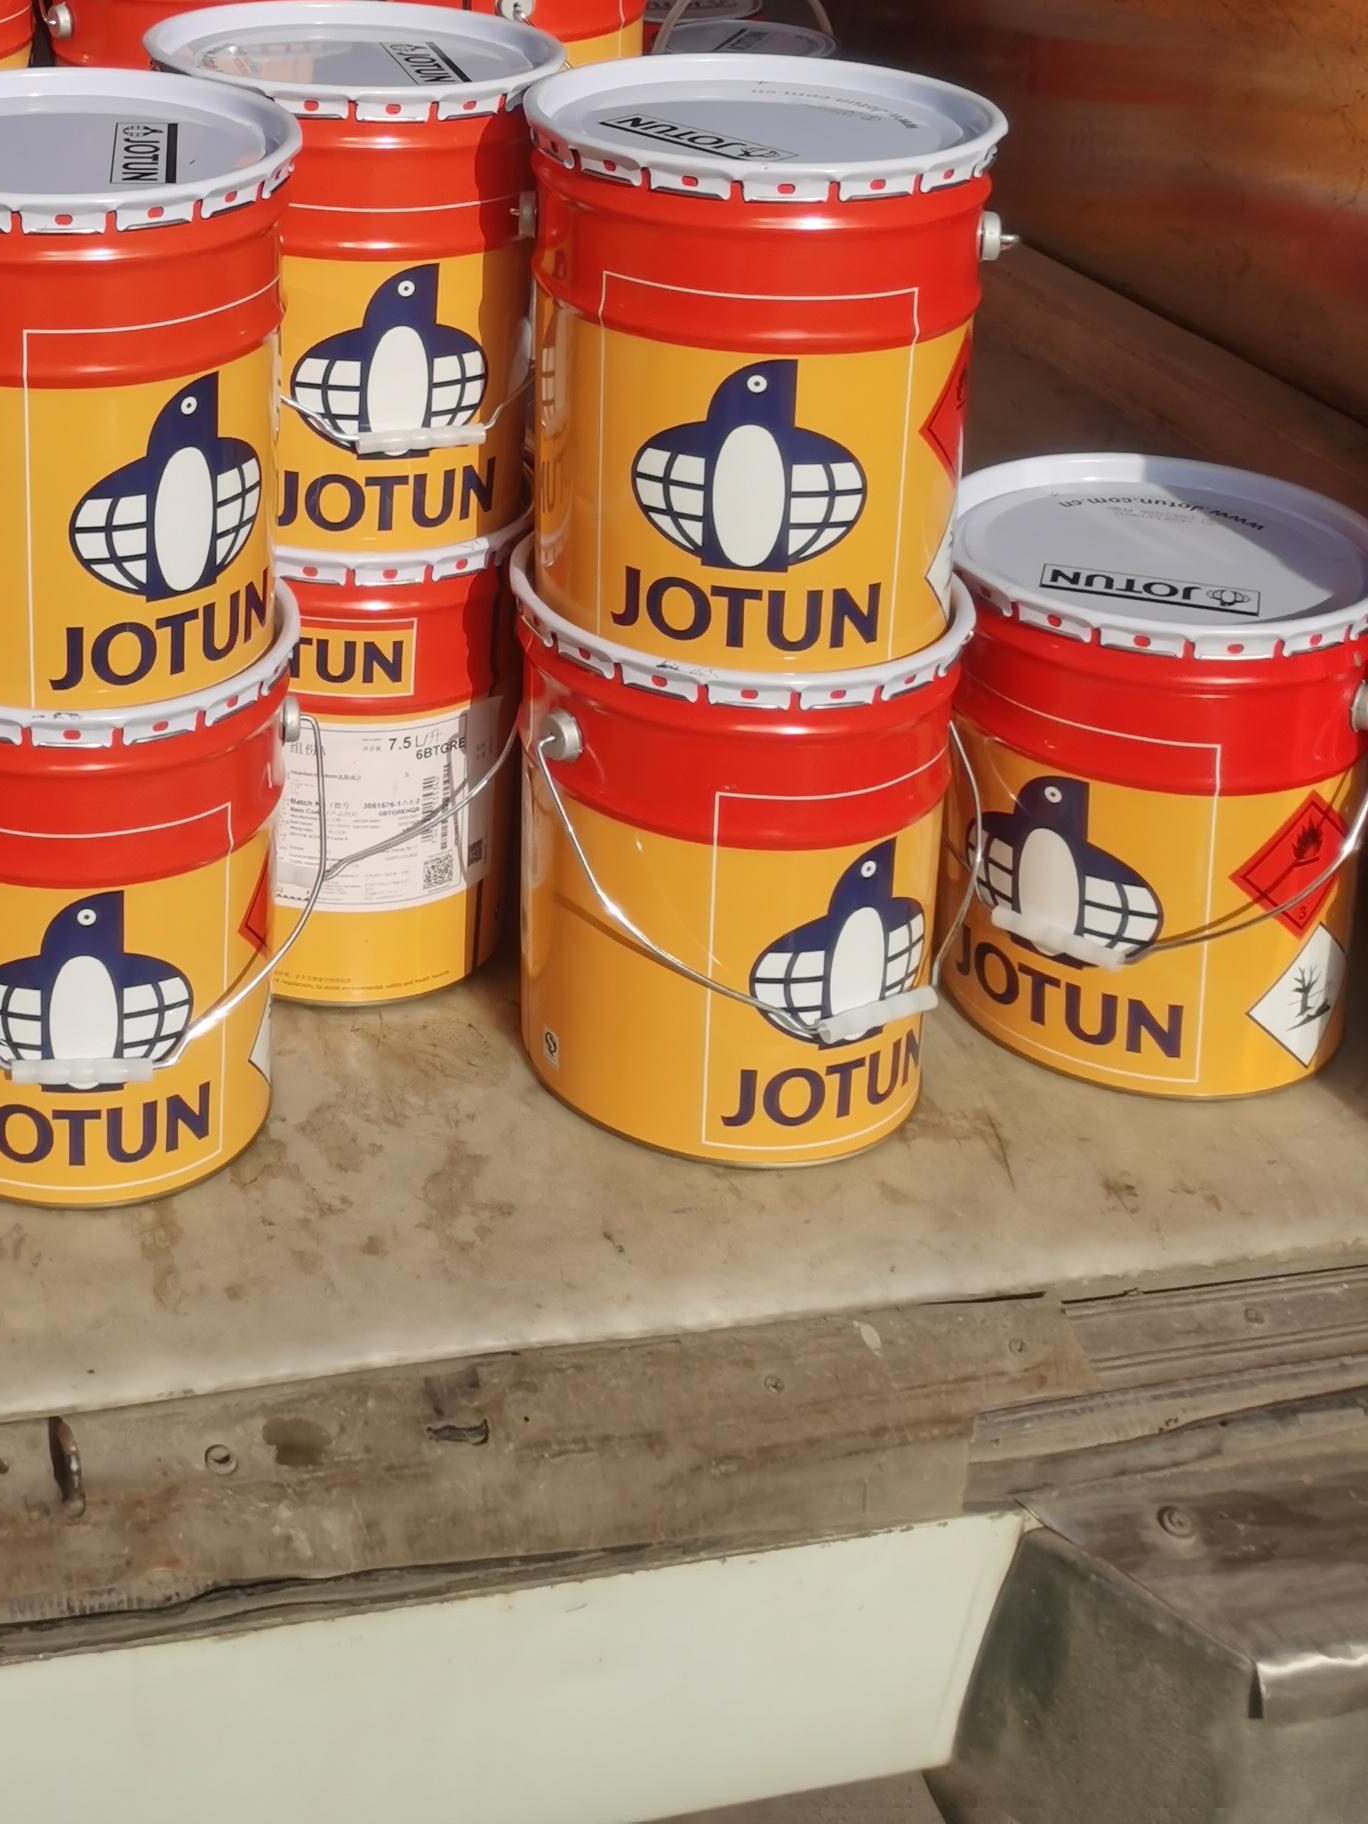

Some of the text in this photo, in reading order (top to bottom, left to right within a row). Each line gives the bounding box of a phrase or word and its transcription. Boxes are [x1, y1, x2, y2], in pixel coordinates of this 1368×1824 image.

[617, 116, 744, 148] JOTUN
[122, 138, 159, 182] JOTUN
[277, 457, 495, 532] JOTUN
[1051, 568, 1202, 601] JOTUN
[611, 565, 880, 650] JOTUN
[49, 566, 270, 690] JOTUN
[389, 736, 411, 751] 7.5
[416, 737, 465, 759] 6BTGRE
[1298, 905, 1308, 921] 3
[956, 925, 1183, 1059] JOTUN
